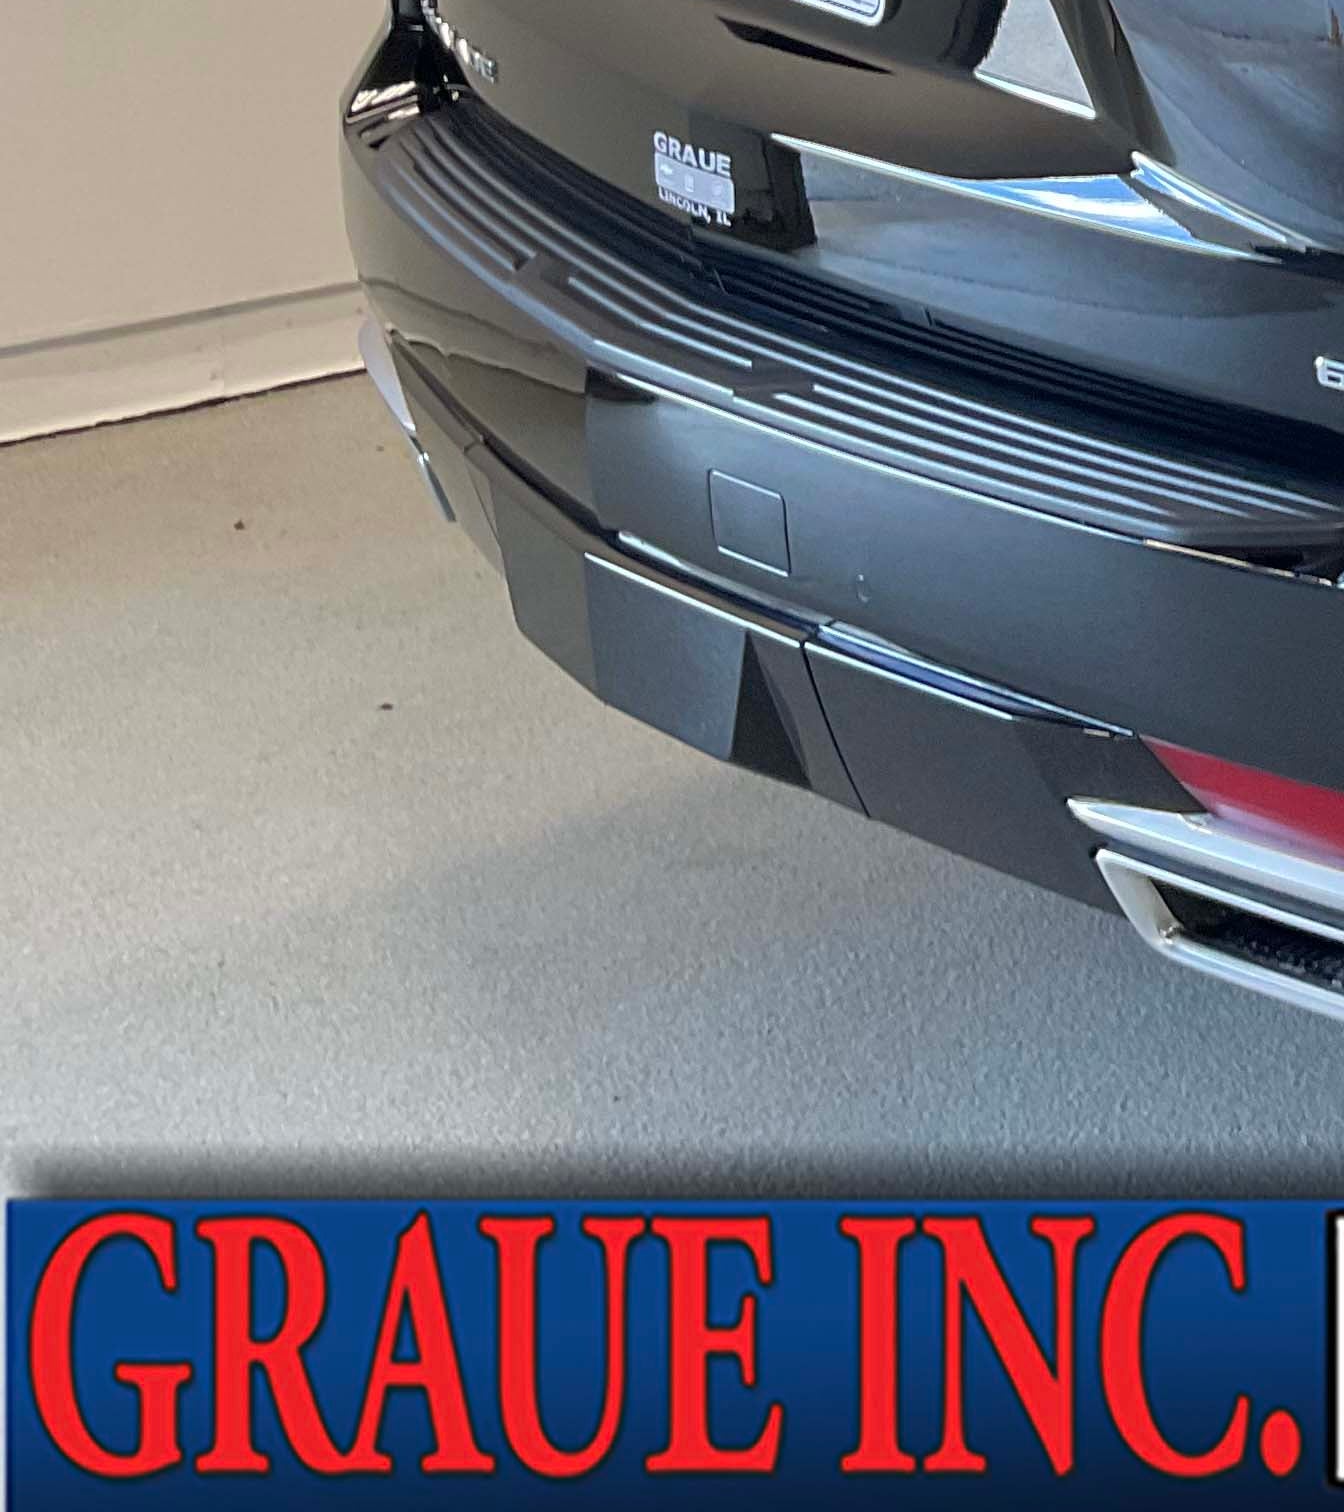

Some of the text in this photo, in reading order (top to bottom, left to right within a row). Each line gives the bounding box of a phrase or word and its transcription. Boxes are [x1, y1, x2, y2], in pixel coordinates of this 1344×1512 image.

[653, 130, 732, 178] GRAUE
[658, 185, 732, 227] LINCOLN, IL
